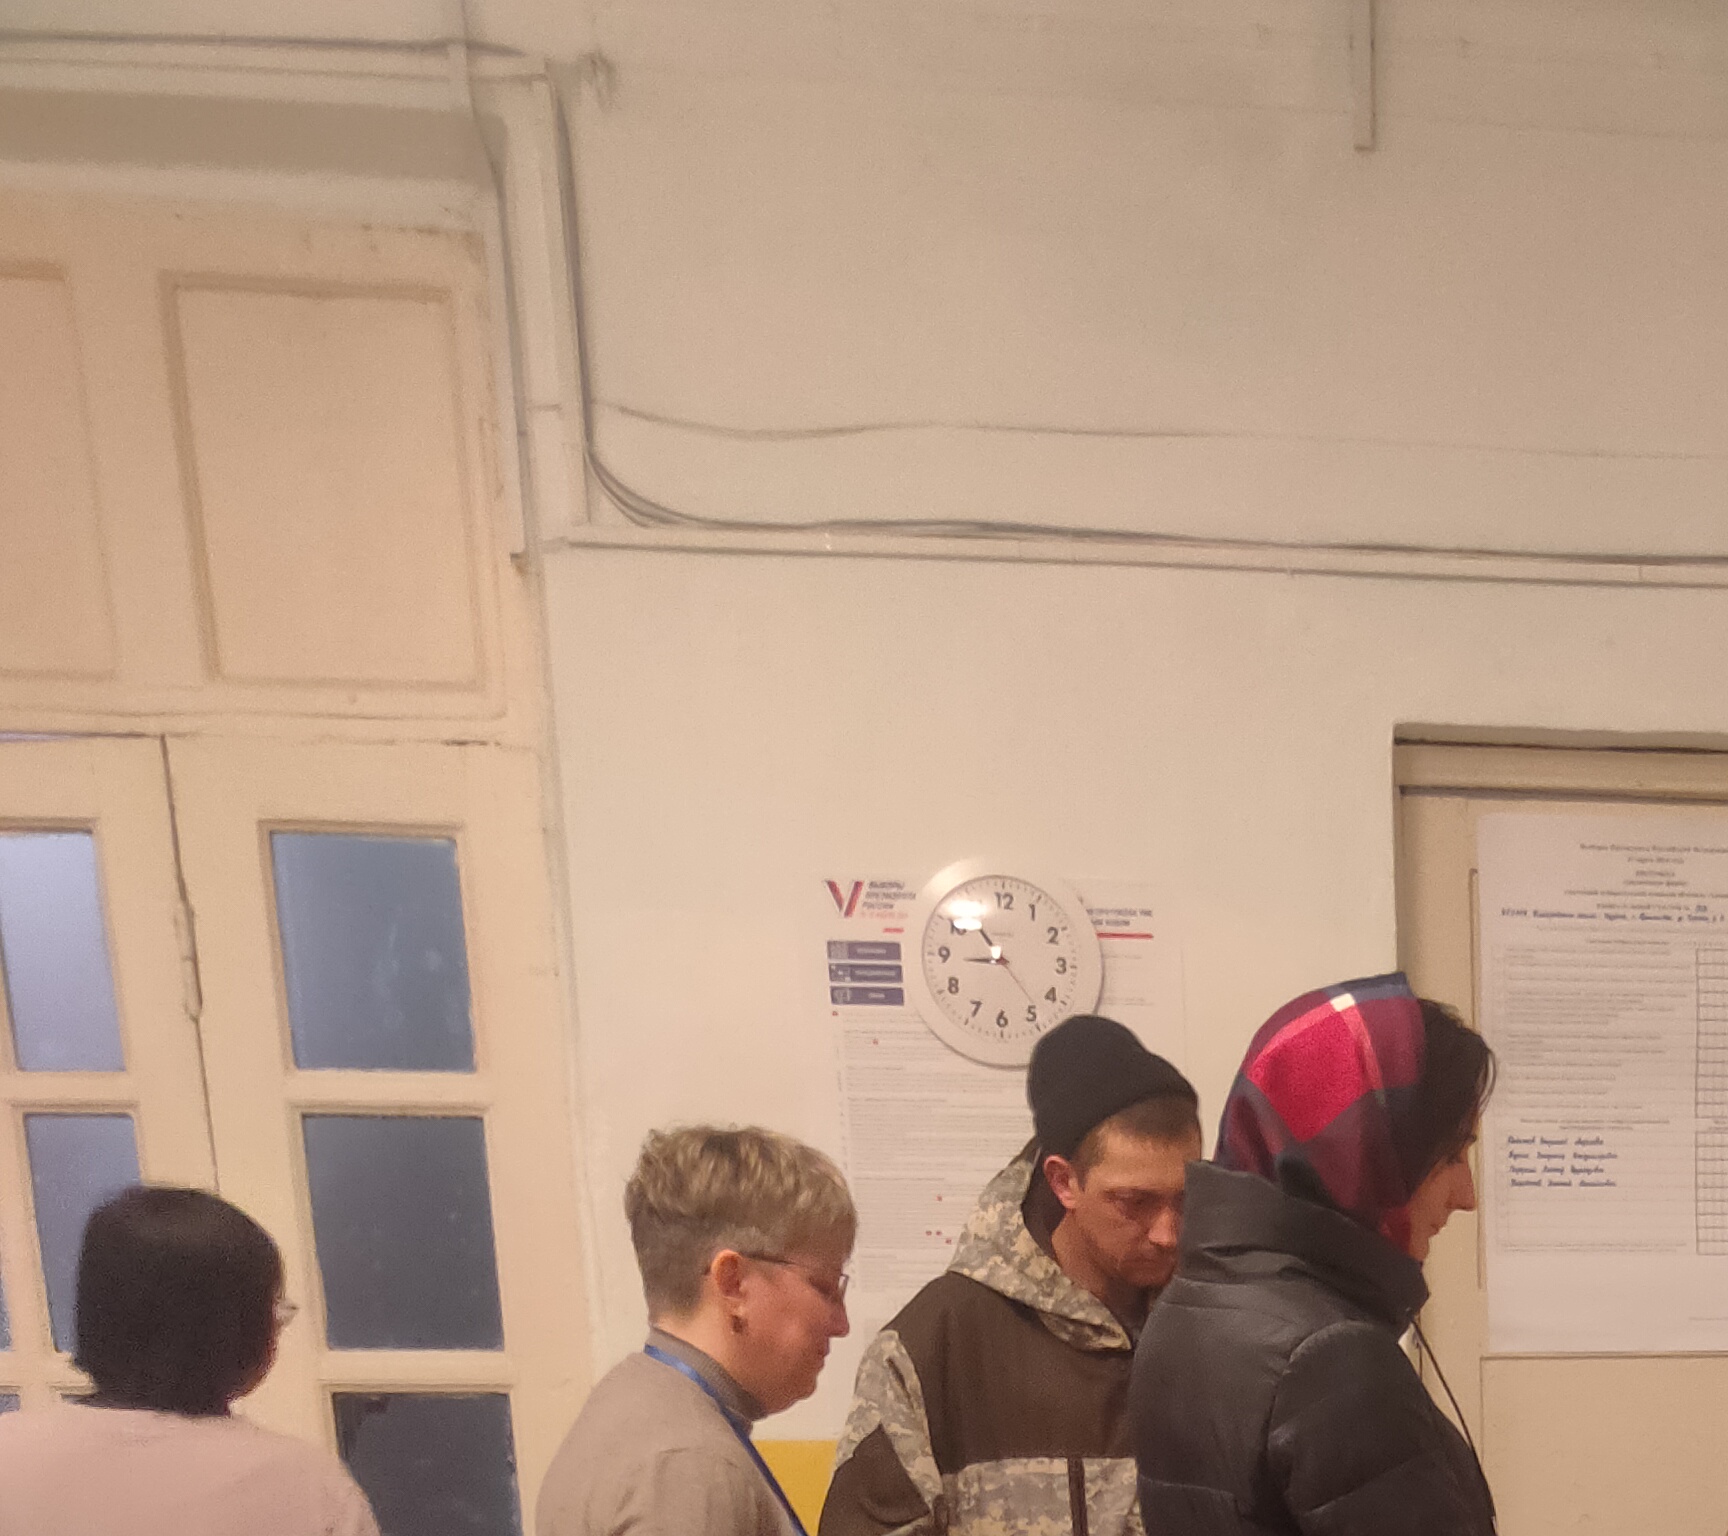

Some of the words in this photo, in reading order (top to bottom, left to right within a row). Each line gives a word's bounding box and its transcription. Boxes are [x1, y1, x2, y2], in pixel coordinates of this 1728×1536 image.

[995, 892, 1015, 910] 12
[1029, 904, 1036, 921] 1
[1047, 927, 1059, 944] 2
[938, 947, 950, 963] 9
[1056, 957, 1067, 974] 3
[948, 977, 959, 994] 8
[1045, 986, 1057, 1003] 4
[970, 1001, 982, 1017] 7
[1026, 1005, 1037, 1022] 5
[996, 1011, 1008, 1027] 6
